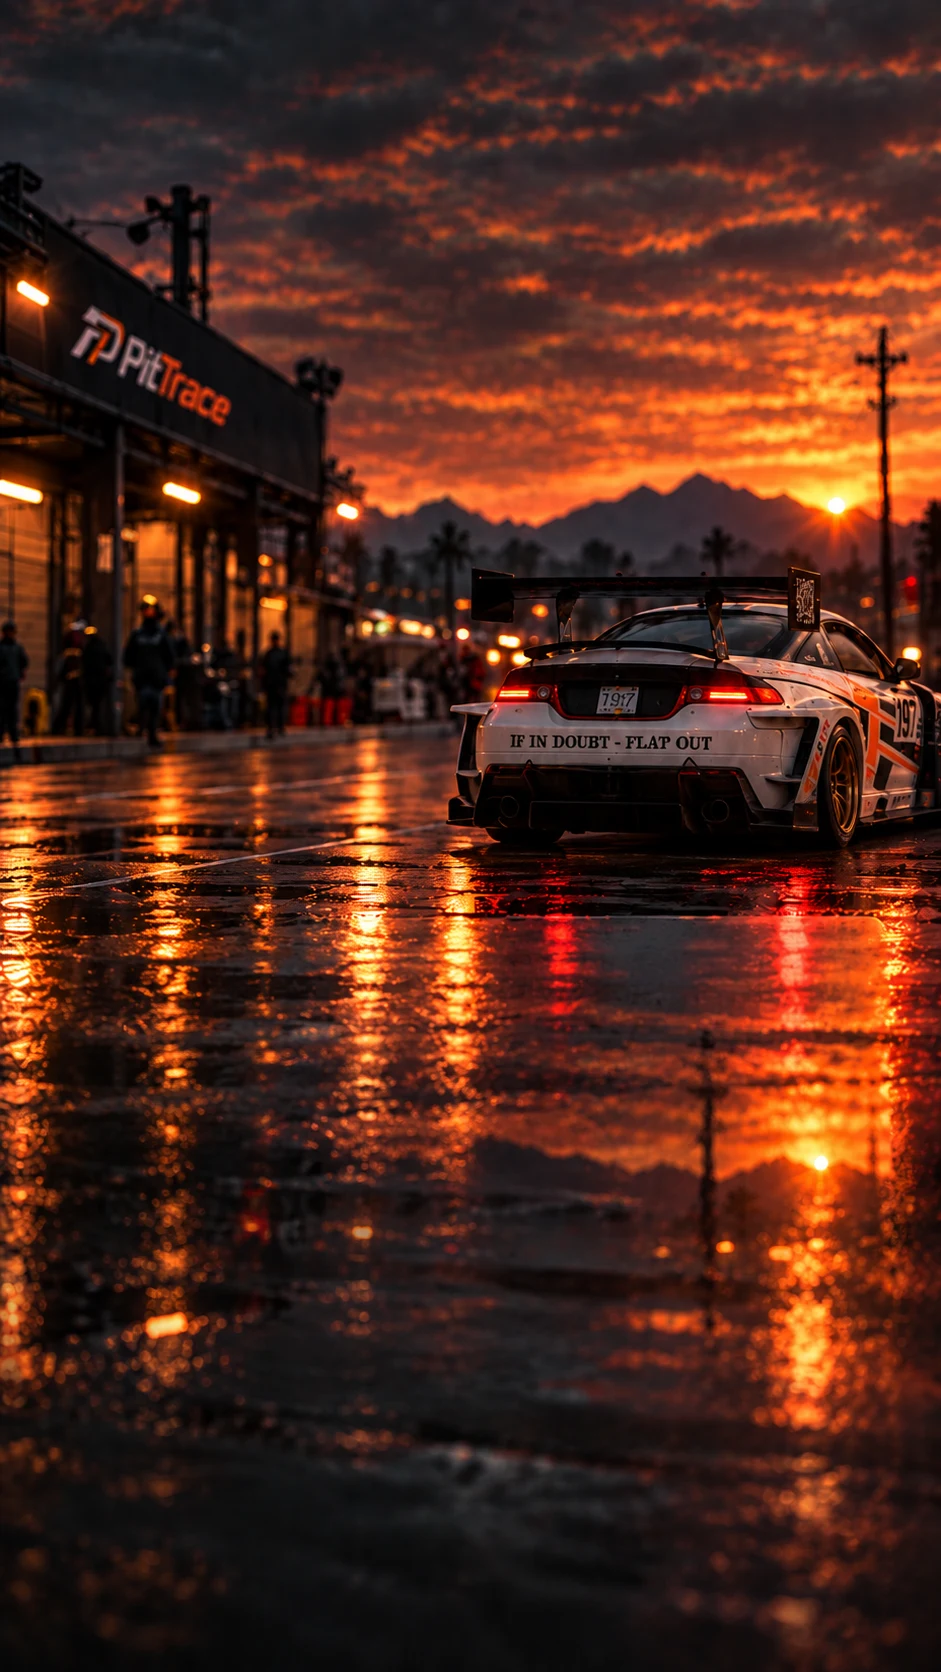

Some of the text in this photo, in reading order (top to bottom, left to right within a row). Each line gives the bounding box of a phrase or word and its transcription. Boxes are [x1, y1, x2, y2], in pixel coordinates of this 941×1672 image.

[117, 334, 232, 427] PitTrace
[897, 698, 917, 738] 197
[510, 734, 526, 748] IF
[528, 734, 547, 749] IN
[551, 735, 610, 749] DOUBT
[625, 736, 671, 750] FLAP
[675, 736, 713, 751] OUT
